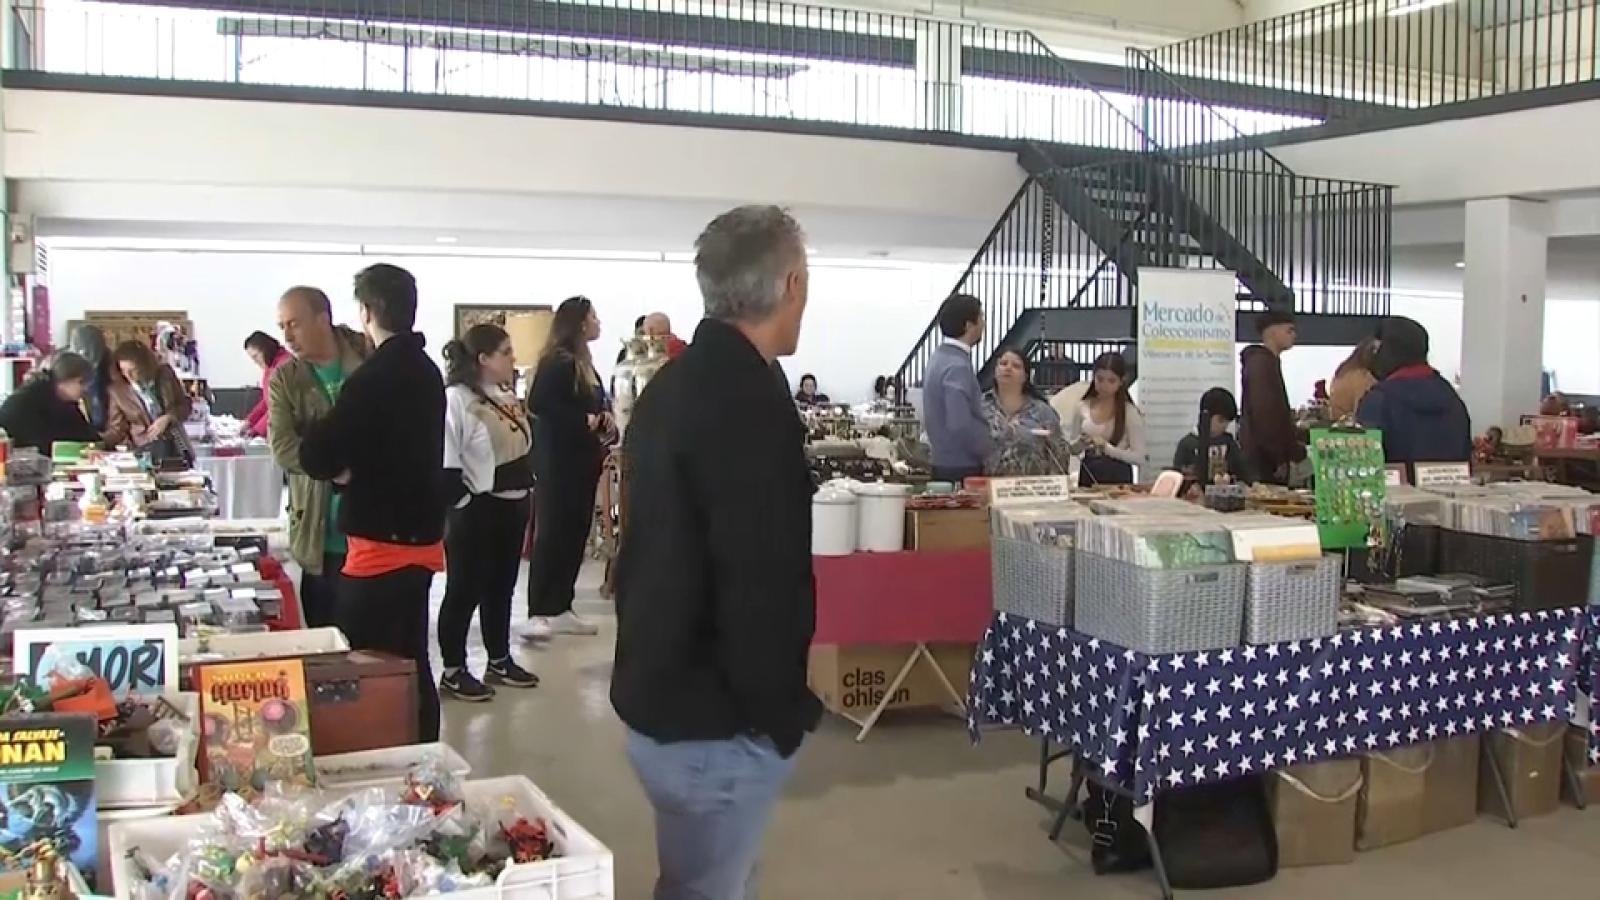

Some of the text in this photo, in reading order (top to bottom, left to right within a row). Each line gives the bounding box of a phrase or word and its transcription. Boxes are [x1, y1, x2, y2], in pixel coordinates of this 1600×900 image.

[1143, 301, 1214, 322] Mercado
[1142, 323, 1231, 338] Coleccionismo
[842, 667, 886, 687] clas
